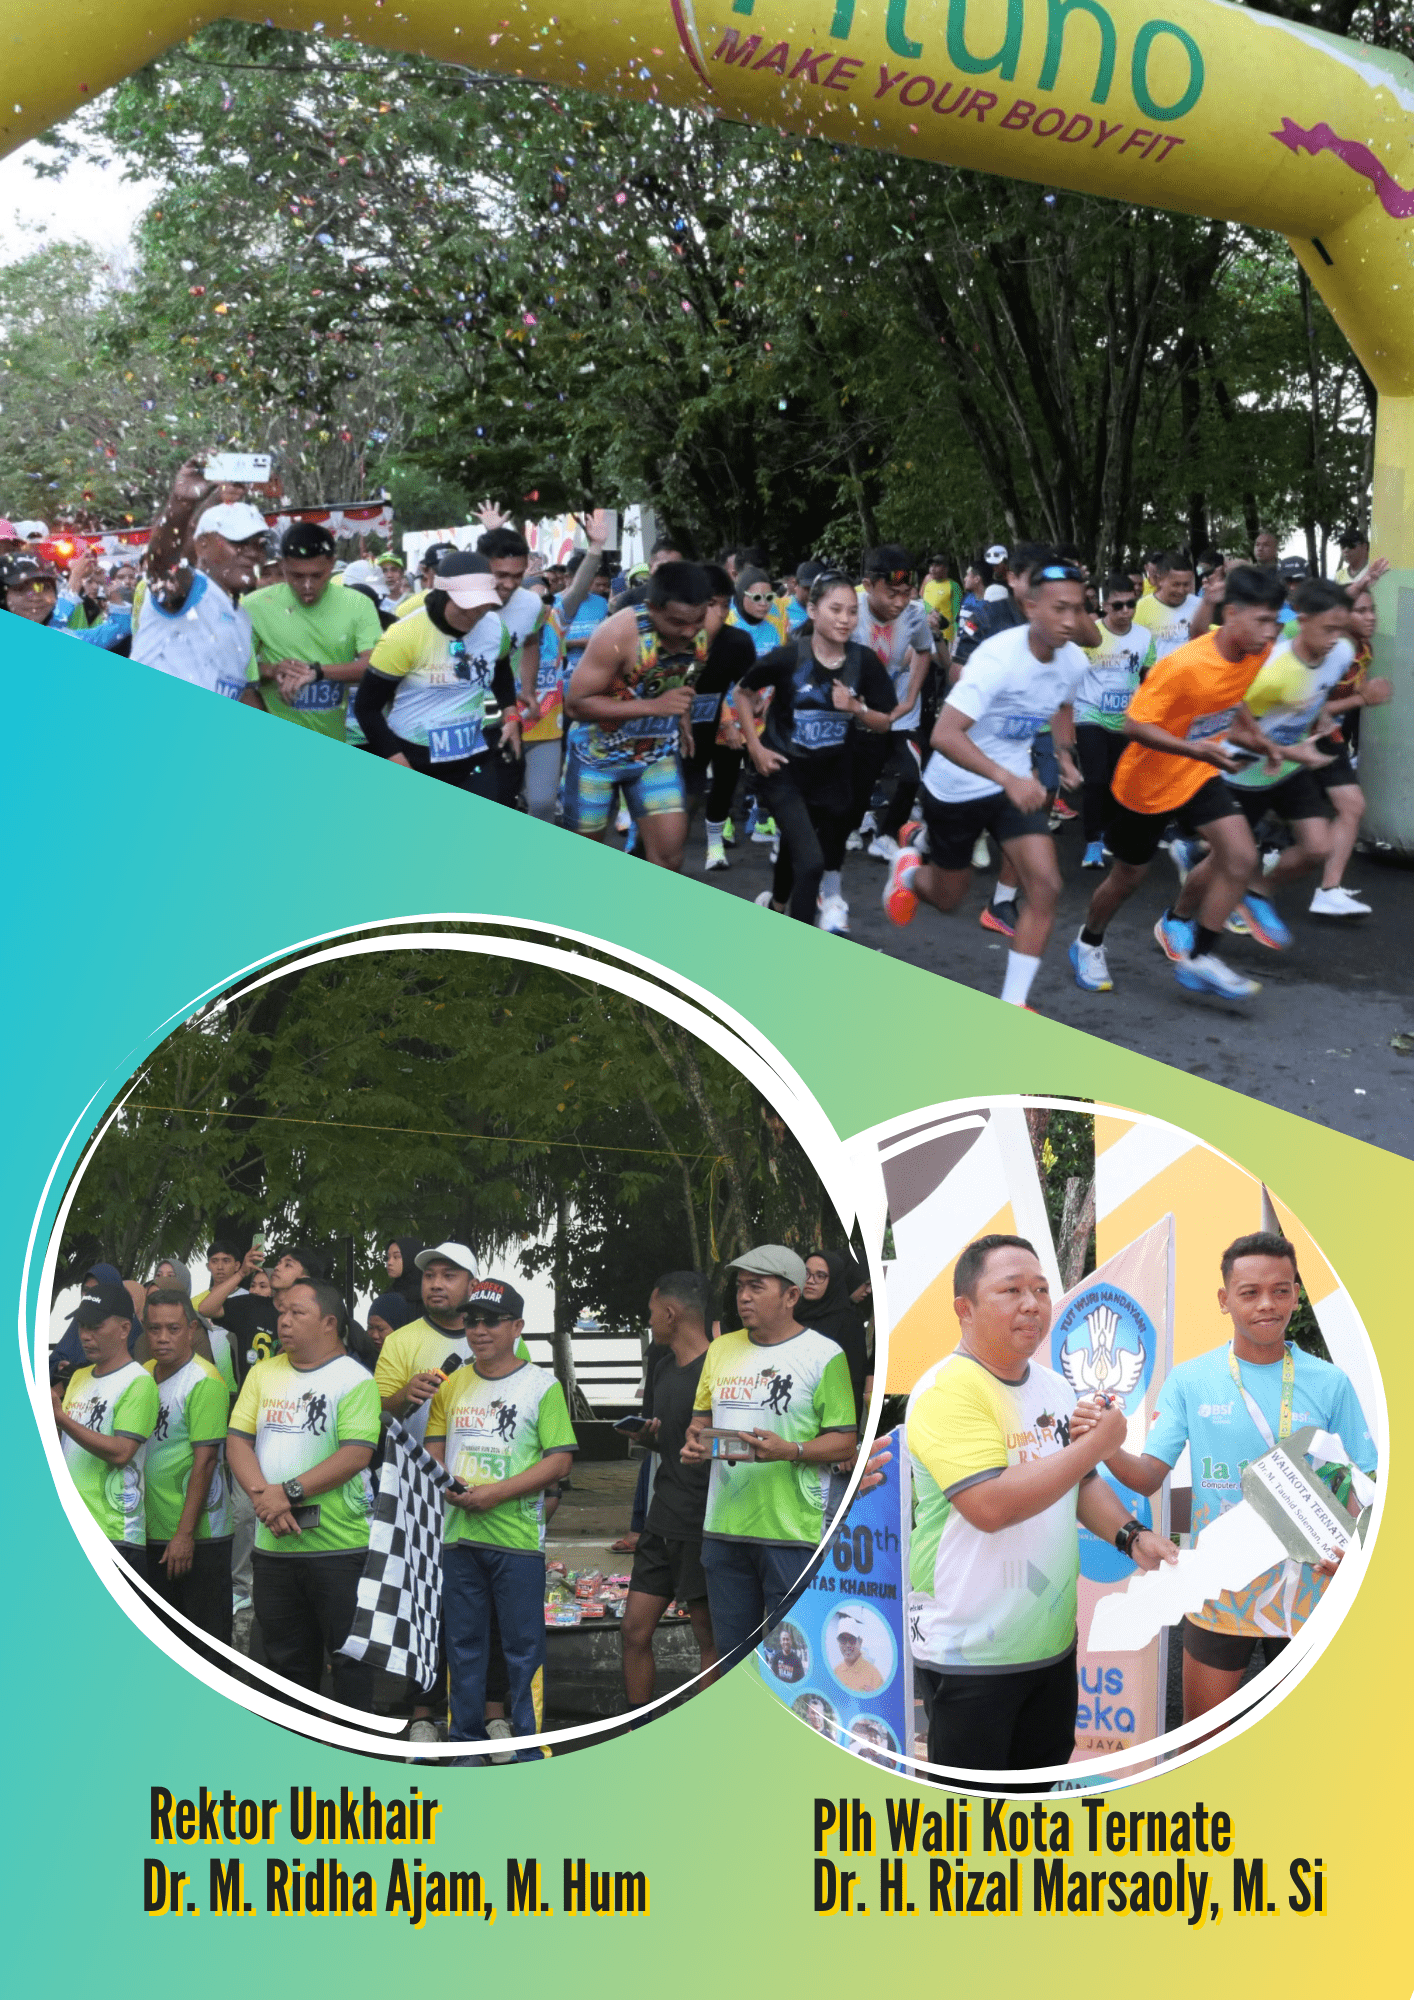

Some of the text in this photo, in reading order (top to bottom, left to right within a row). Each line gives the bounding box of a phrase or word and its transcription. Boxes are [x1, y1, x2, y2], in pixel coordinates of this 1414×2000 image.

[710, 27, 1187, 163] MAKE YOUR BODY FIT
[536, 669, 557, 686] 56
[1103, 692, 1128, 708] M08
[796, 720, 847, 740] M025
[1060, 1307, 1076, 1332] TUT
[717, 1373, 769, 1390] UNKHAIR
[719, 1386, 754, 1400] RUN
[454, 1416, 486, 1428] RUN
[1006, 1424, 1055, 1450] UAIR
[1271, 1451, 1348, 1548] WALIKOTA TERNATE
[1275, 1482, 1298, 1510] Tauhid
[839, 1578, 898, 1600] KHAIRUN
[1086, 1739, 1125, 1751] JAYA
